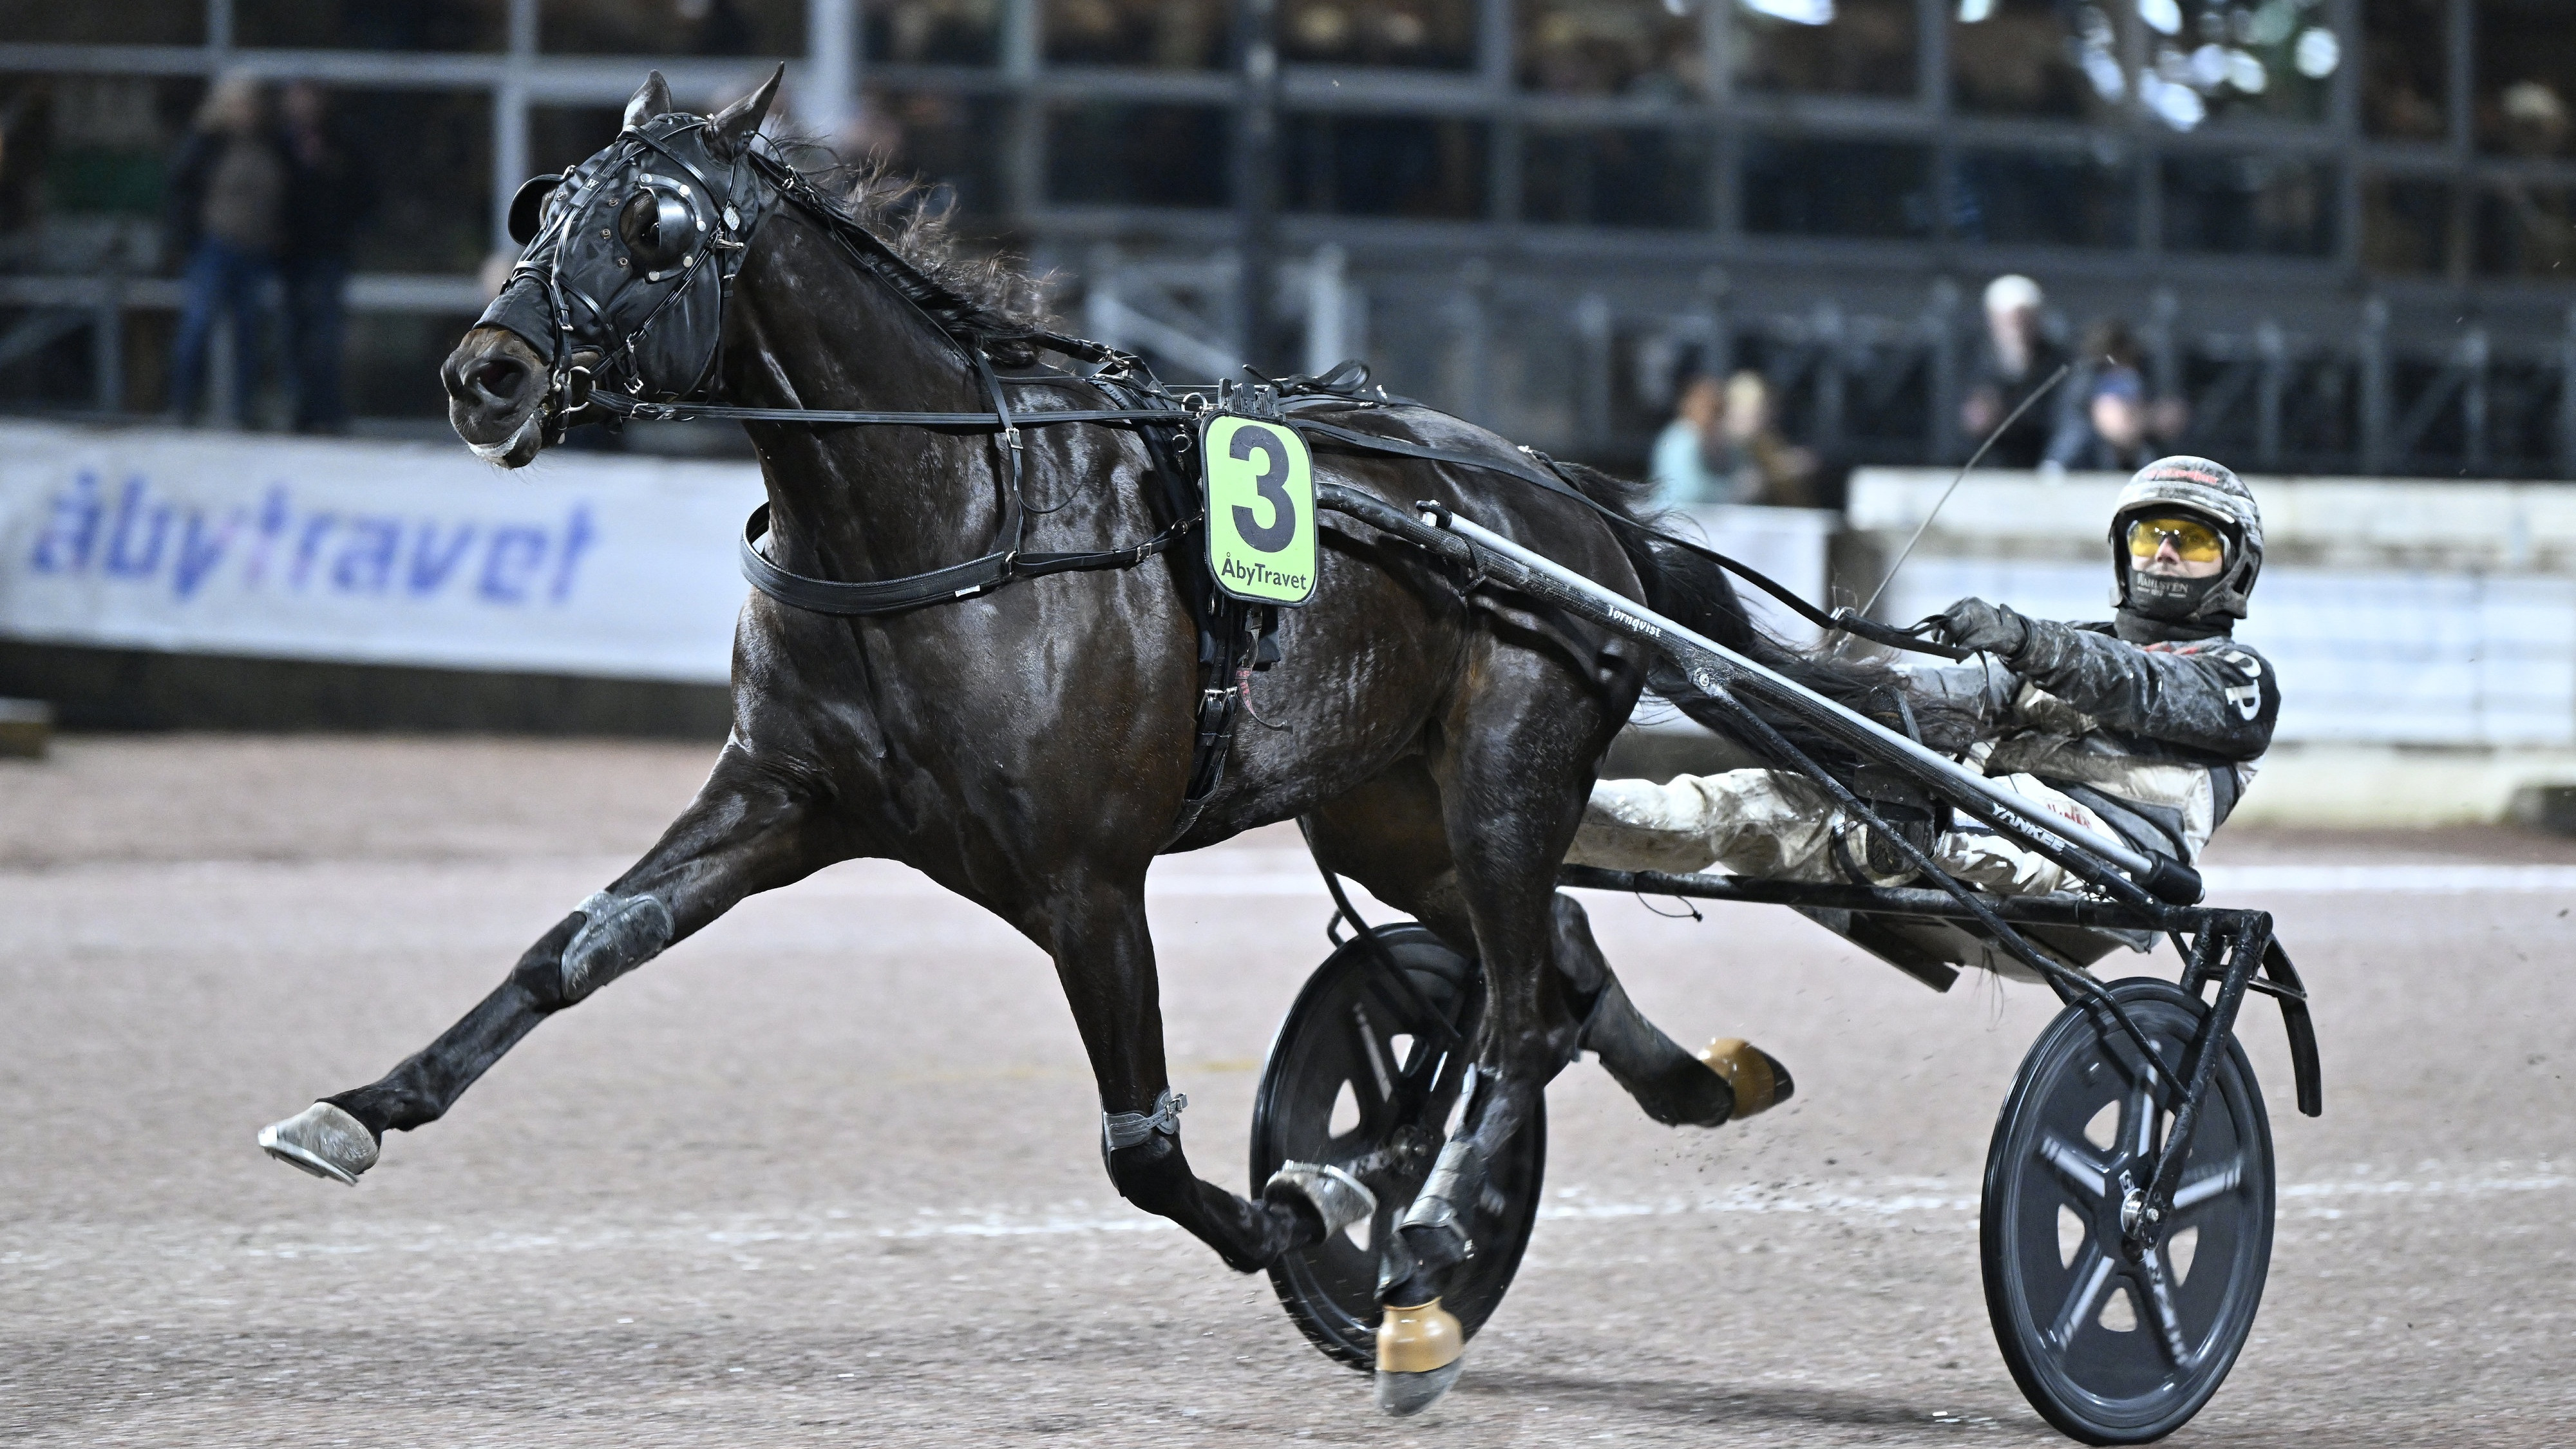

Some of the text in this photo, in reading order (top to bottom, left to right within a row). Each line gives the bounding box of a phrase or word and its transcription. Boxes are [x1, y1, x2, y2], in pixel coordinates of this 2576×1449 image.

[1229, 424, 1296, 553] 3
[1221, 552, 1307, 590] ÅbyTravet
[1993, 802, 2066, 852] YANKEE
